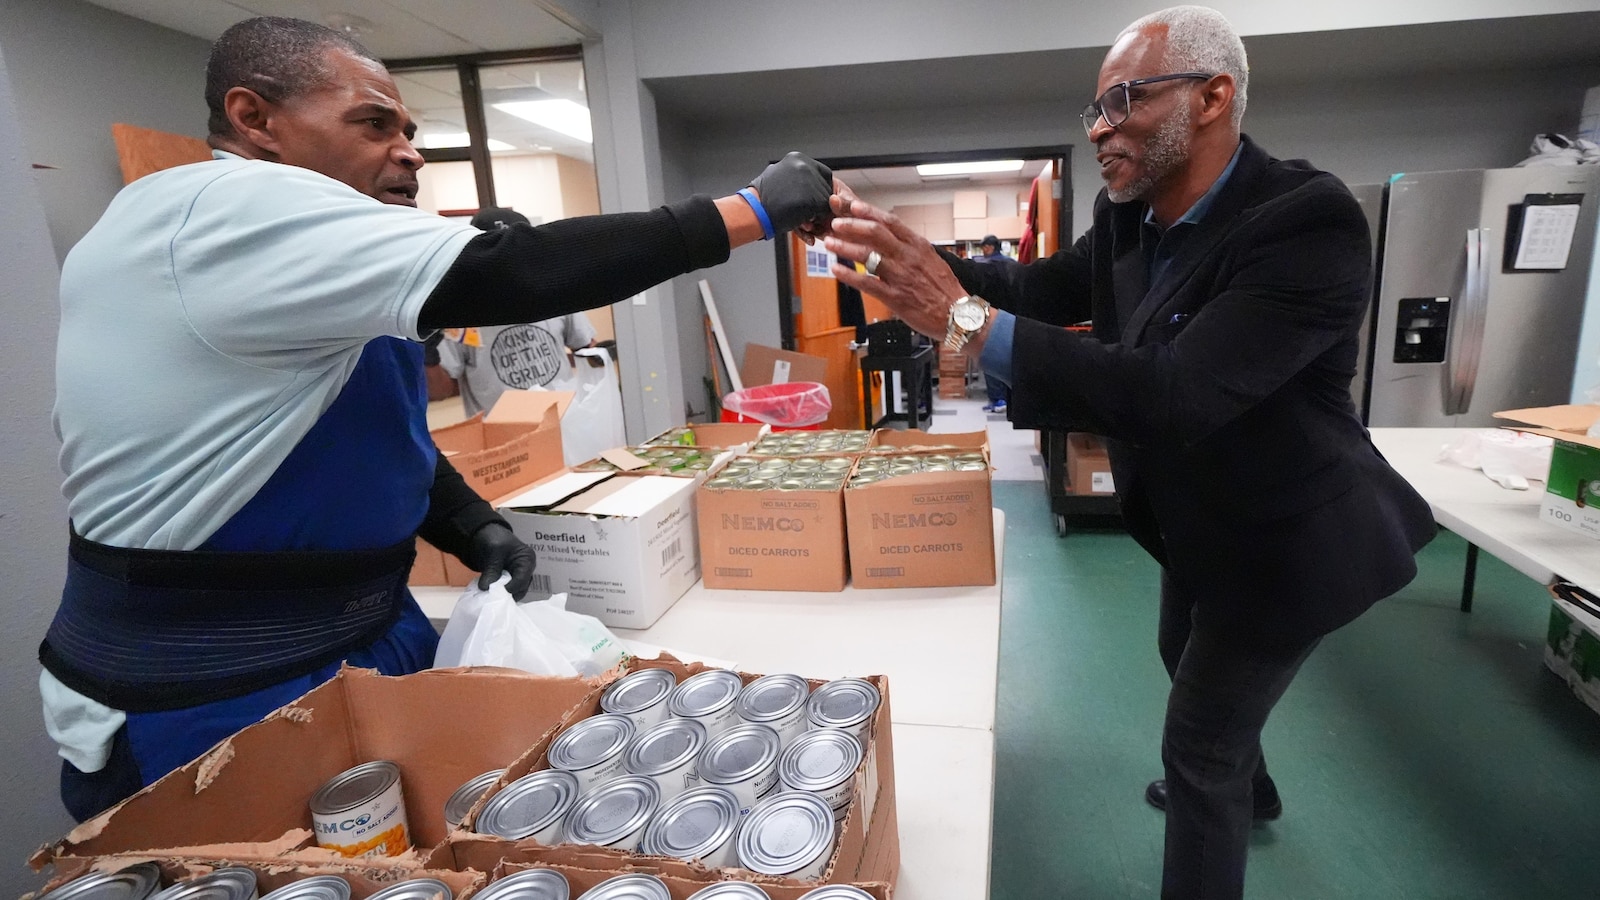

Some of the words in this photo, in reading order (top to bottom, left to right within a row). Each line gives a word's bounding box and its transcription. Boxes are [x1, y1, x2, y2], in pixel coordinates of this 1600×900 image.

[504, 329, 535, 348] KING
[500, 352, 518, 368] OF
[519, 343, 551, 361] THE
[509, 361, 555, 385] GRILL
[721, 513, 805, 532] NEMCO
[871, 512, 958, 530] NEMCO
[1548, 508, 1572, 523] 100
[535, 531, 586, 543] Deerfield
[547, 545, 570, 554] Mixed
[571, 547, 610, 557] Vegetables
[729, 547, 759, 556] DICED
[761, 547, 809, 557] CARROTS
[880, 545, 911, 555] DICED
[913, 543, 964, 553] CARROTS
[367, 820, 381, 831] SALT
